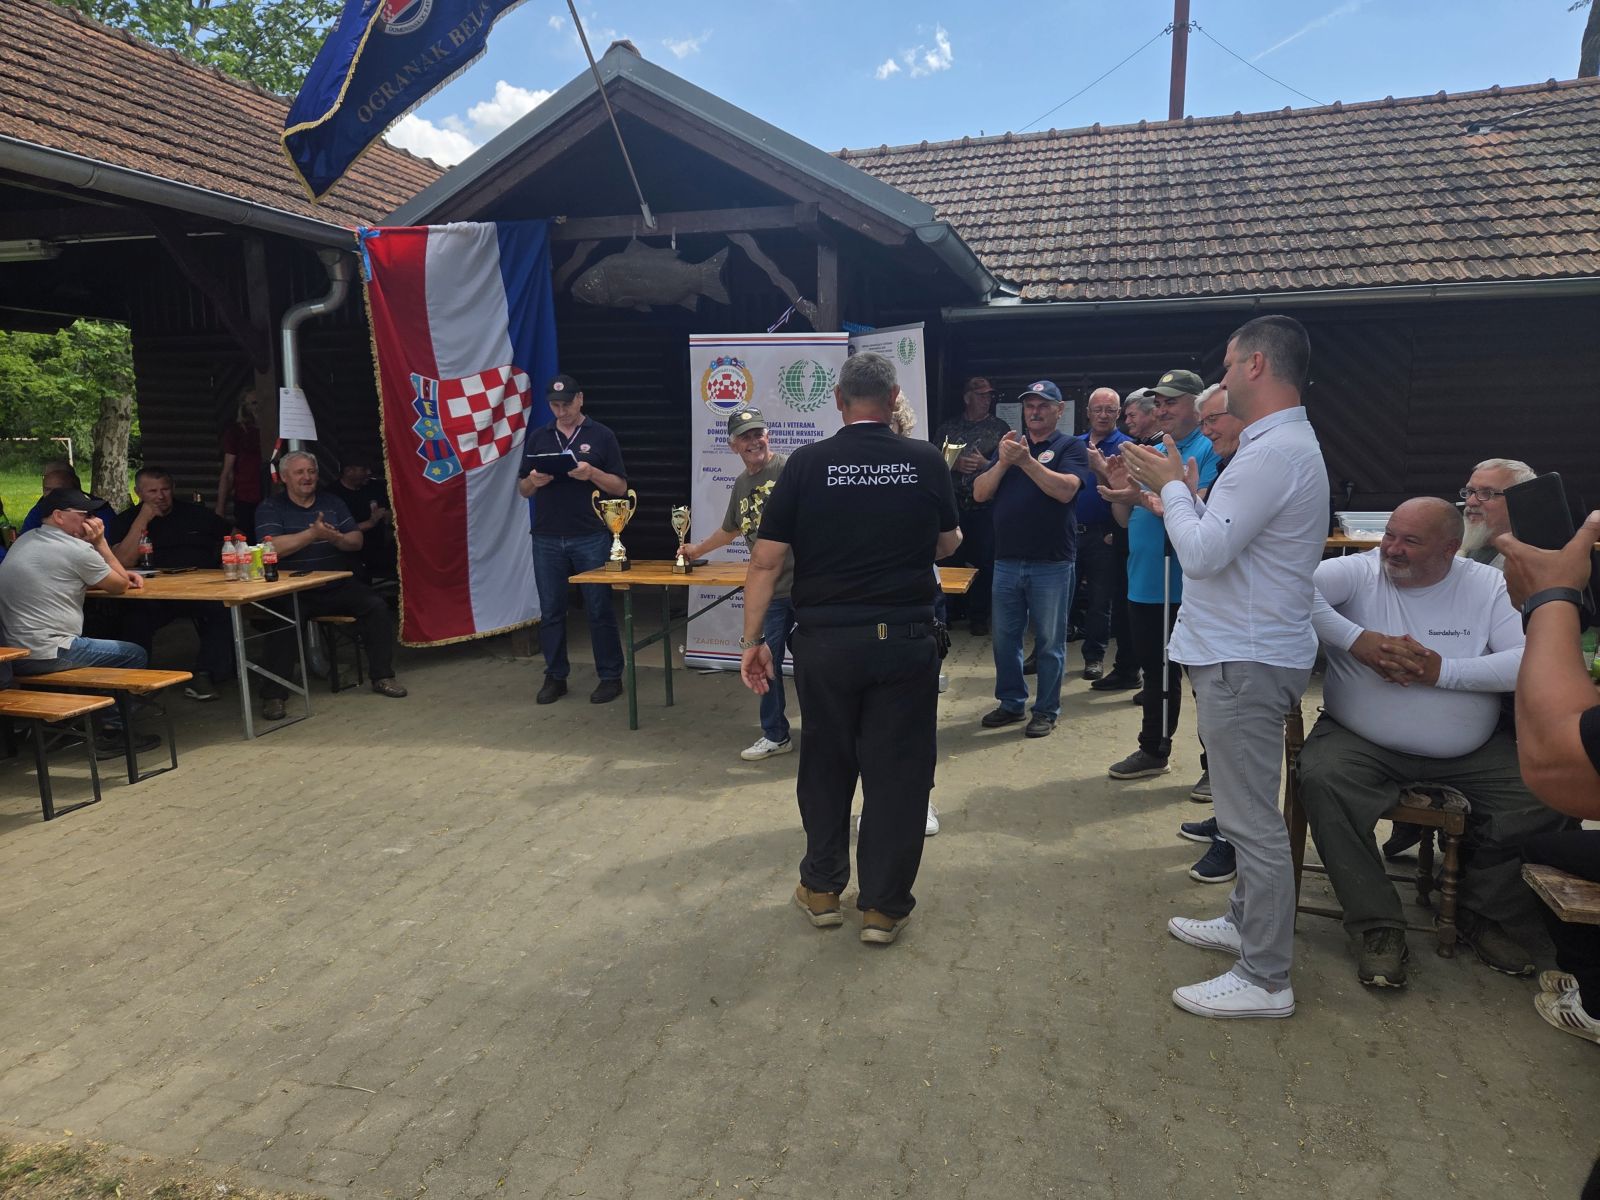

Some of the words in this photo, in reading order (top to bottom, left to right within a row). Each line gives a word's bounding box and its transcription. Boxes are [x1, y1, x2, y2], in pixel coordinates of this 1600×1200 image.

[358, 40, 451, 124] OGRANAK
[787, 421, 816, 429] VETERANA
[827, 462, 917, 475] PODTUREN-
[827, 474, 919, 486] DEKANOVEC
